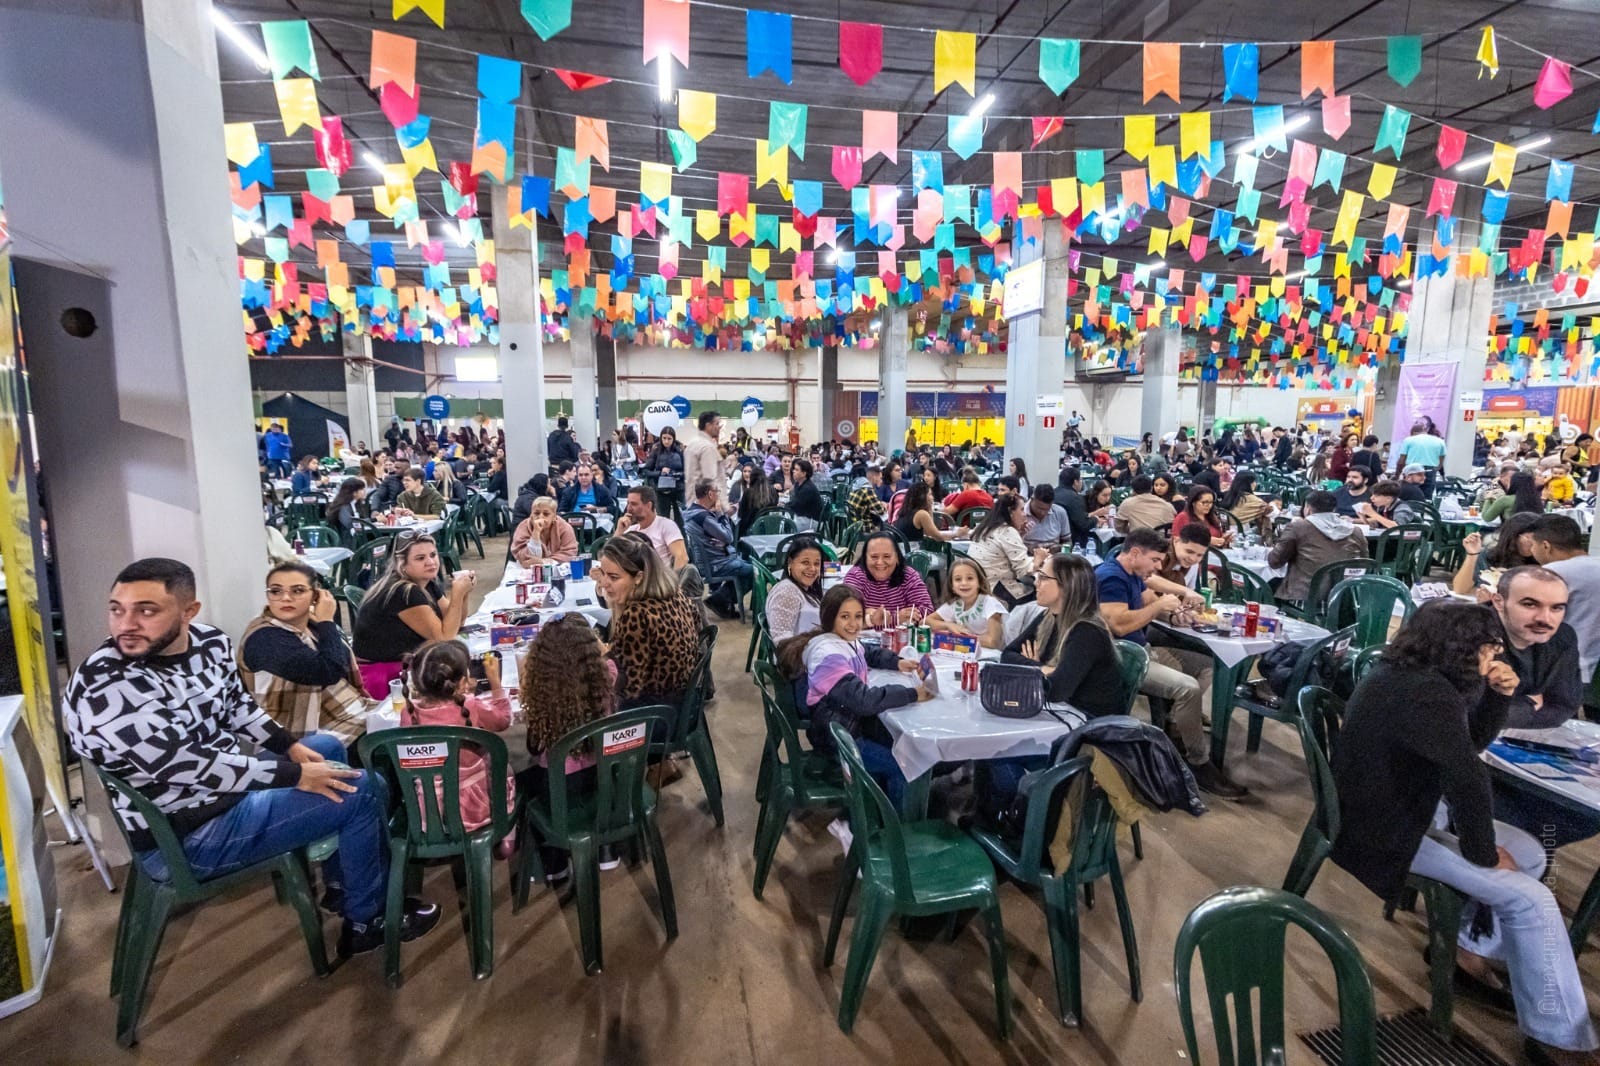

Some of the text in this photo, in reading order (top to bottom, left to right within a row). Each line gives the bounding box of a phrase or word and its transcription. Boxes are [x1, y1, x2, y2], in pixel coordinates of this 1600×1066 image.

[647, 405, 672, 413] CAIXA
[612, 728, 637, 741] KARP
[406, 745, 436, 755] KARP
